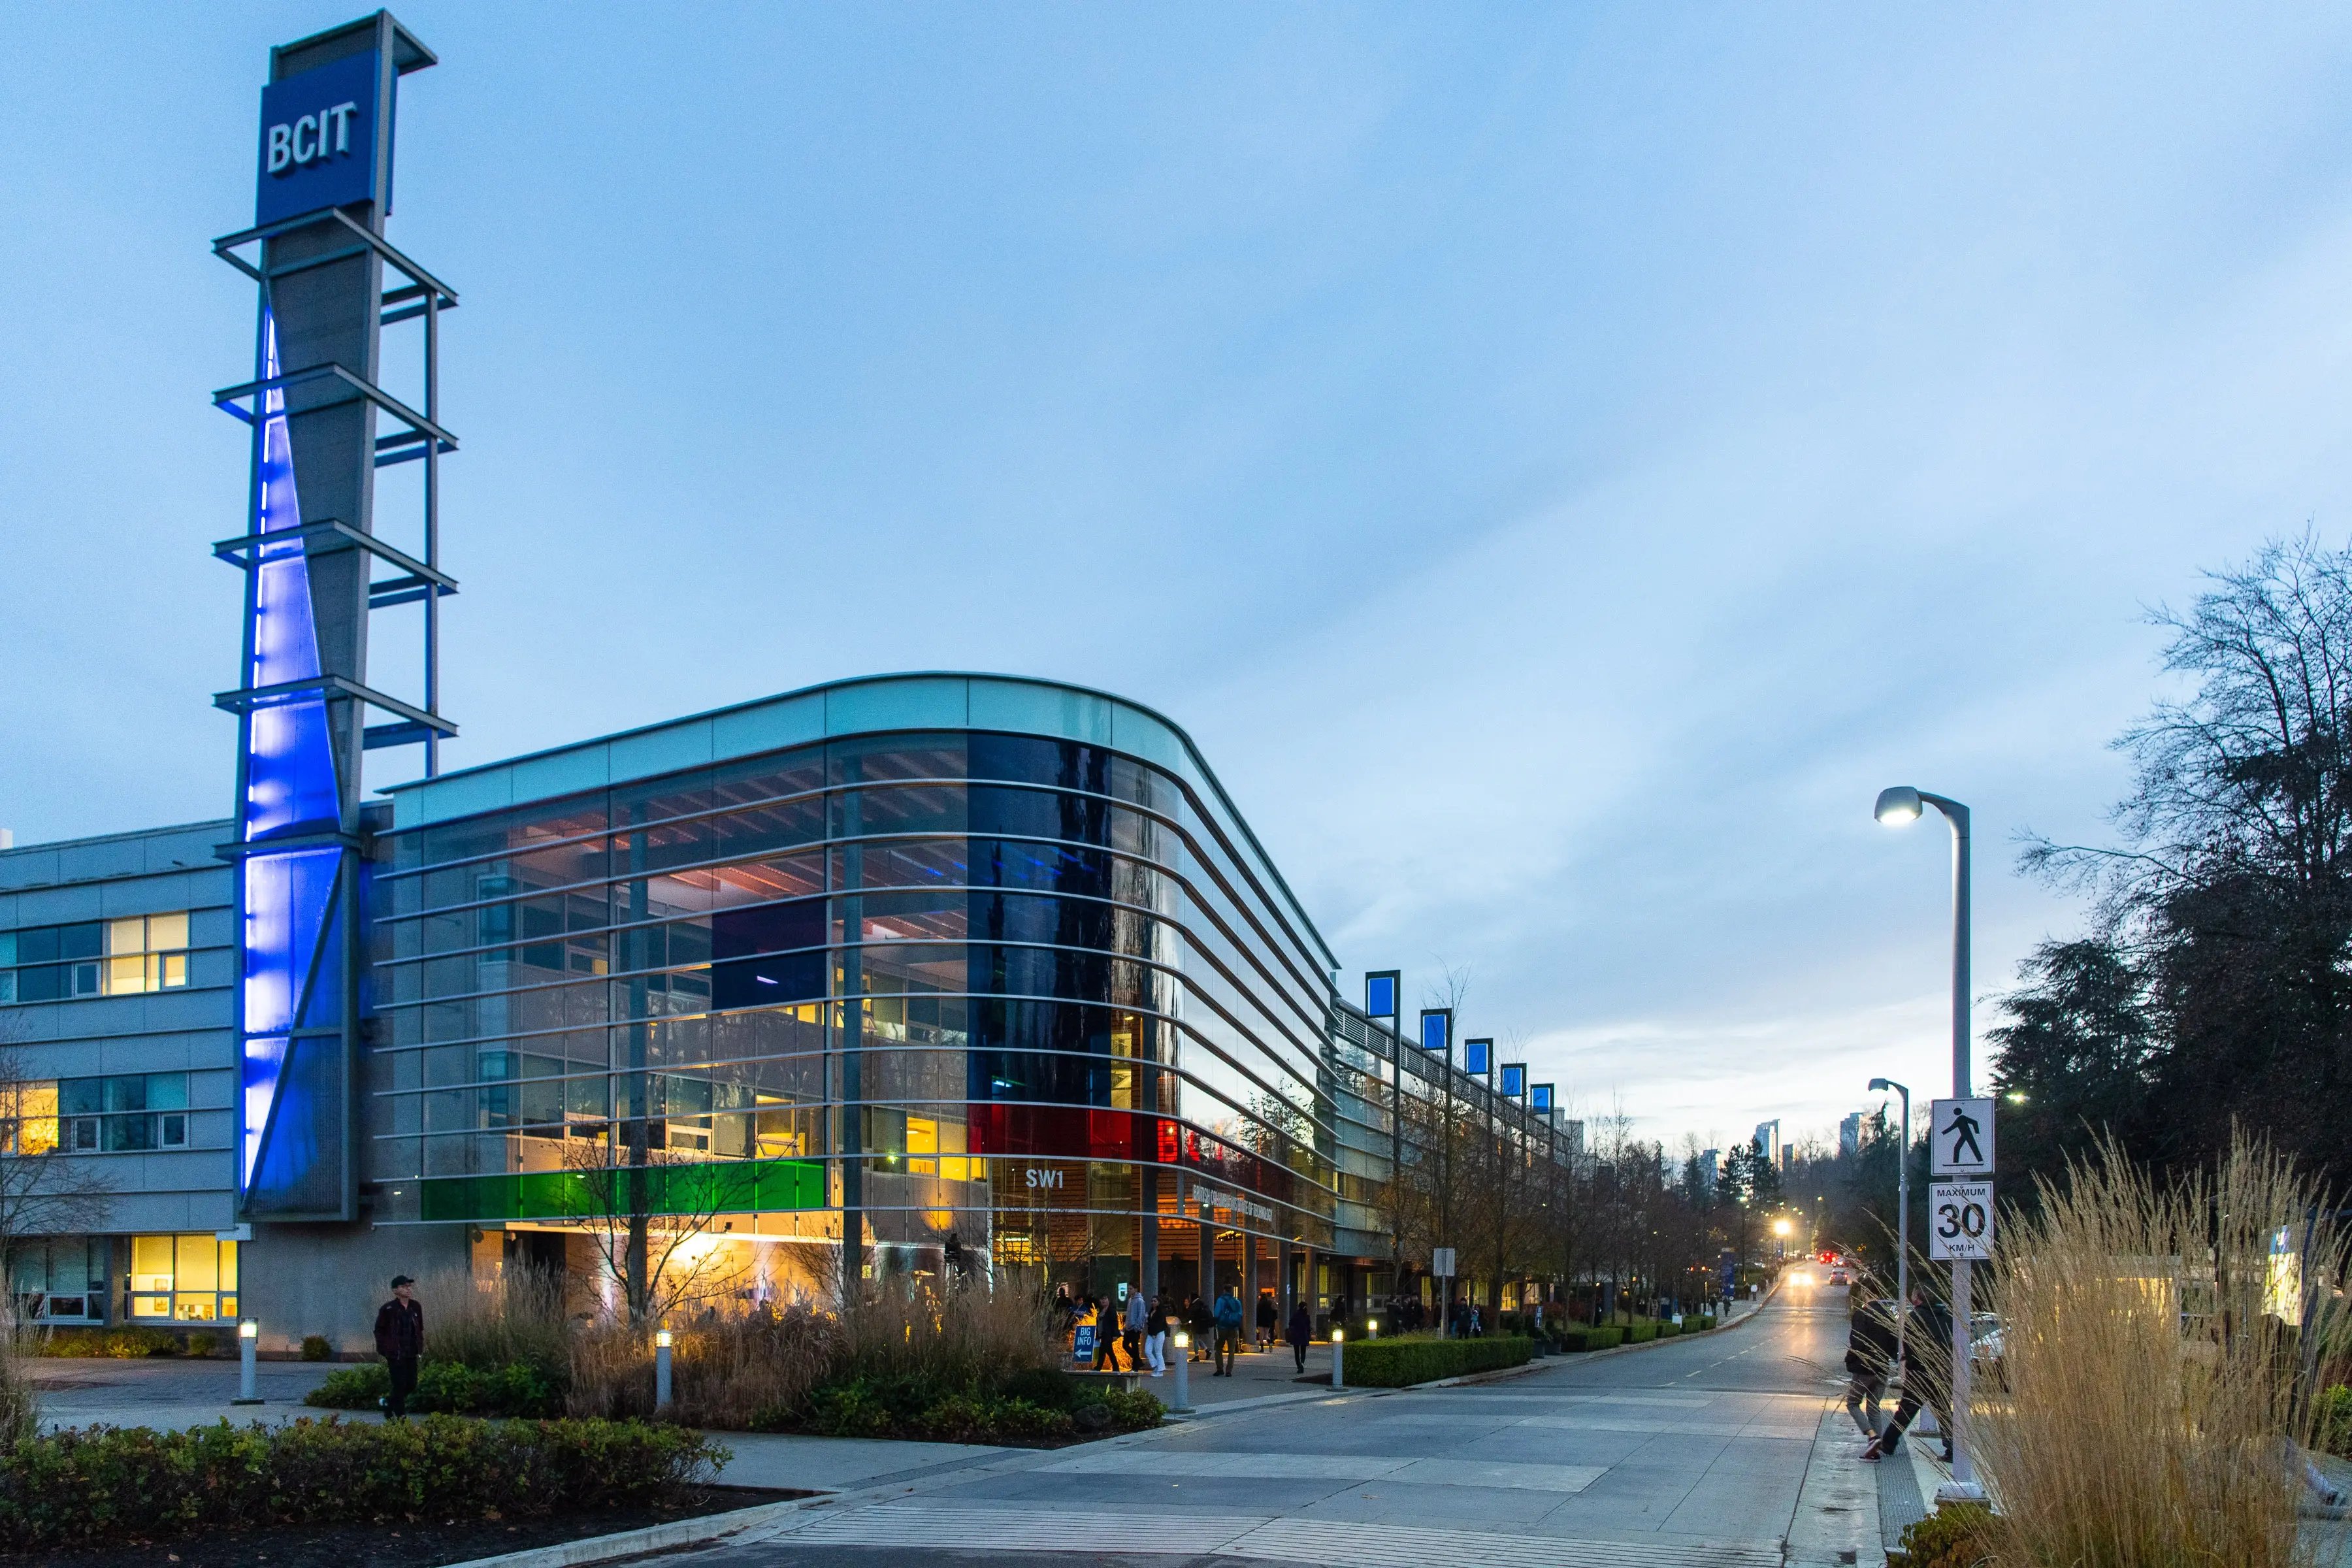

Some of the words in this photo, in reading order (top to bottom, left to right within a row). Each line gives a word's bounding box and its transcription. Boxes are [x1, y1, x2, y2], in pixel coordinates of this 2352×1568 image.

[267, 101, 357, 174] BCIT
[1026, 1169, 1063, 1188] SW1
[1193, 1184, 1211, 1204] BRITISH
[1937, 1188, 1985, 1197] MAXIMUM
[1938, 1203, 1985, 1238] 30
[1077, 1337, 1091, 1345] INFO
[1080, 1327, 1091, 1336] BIG
